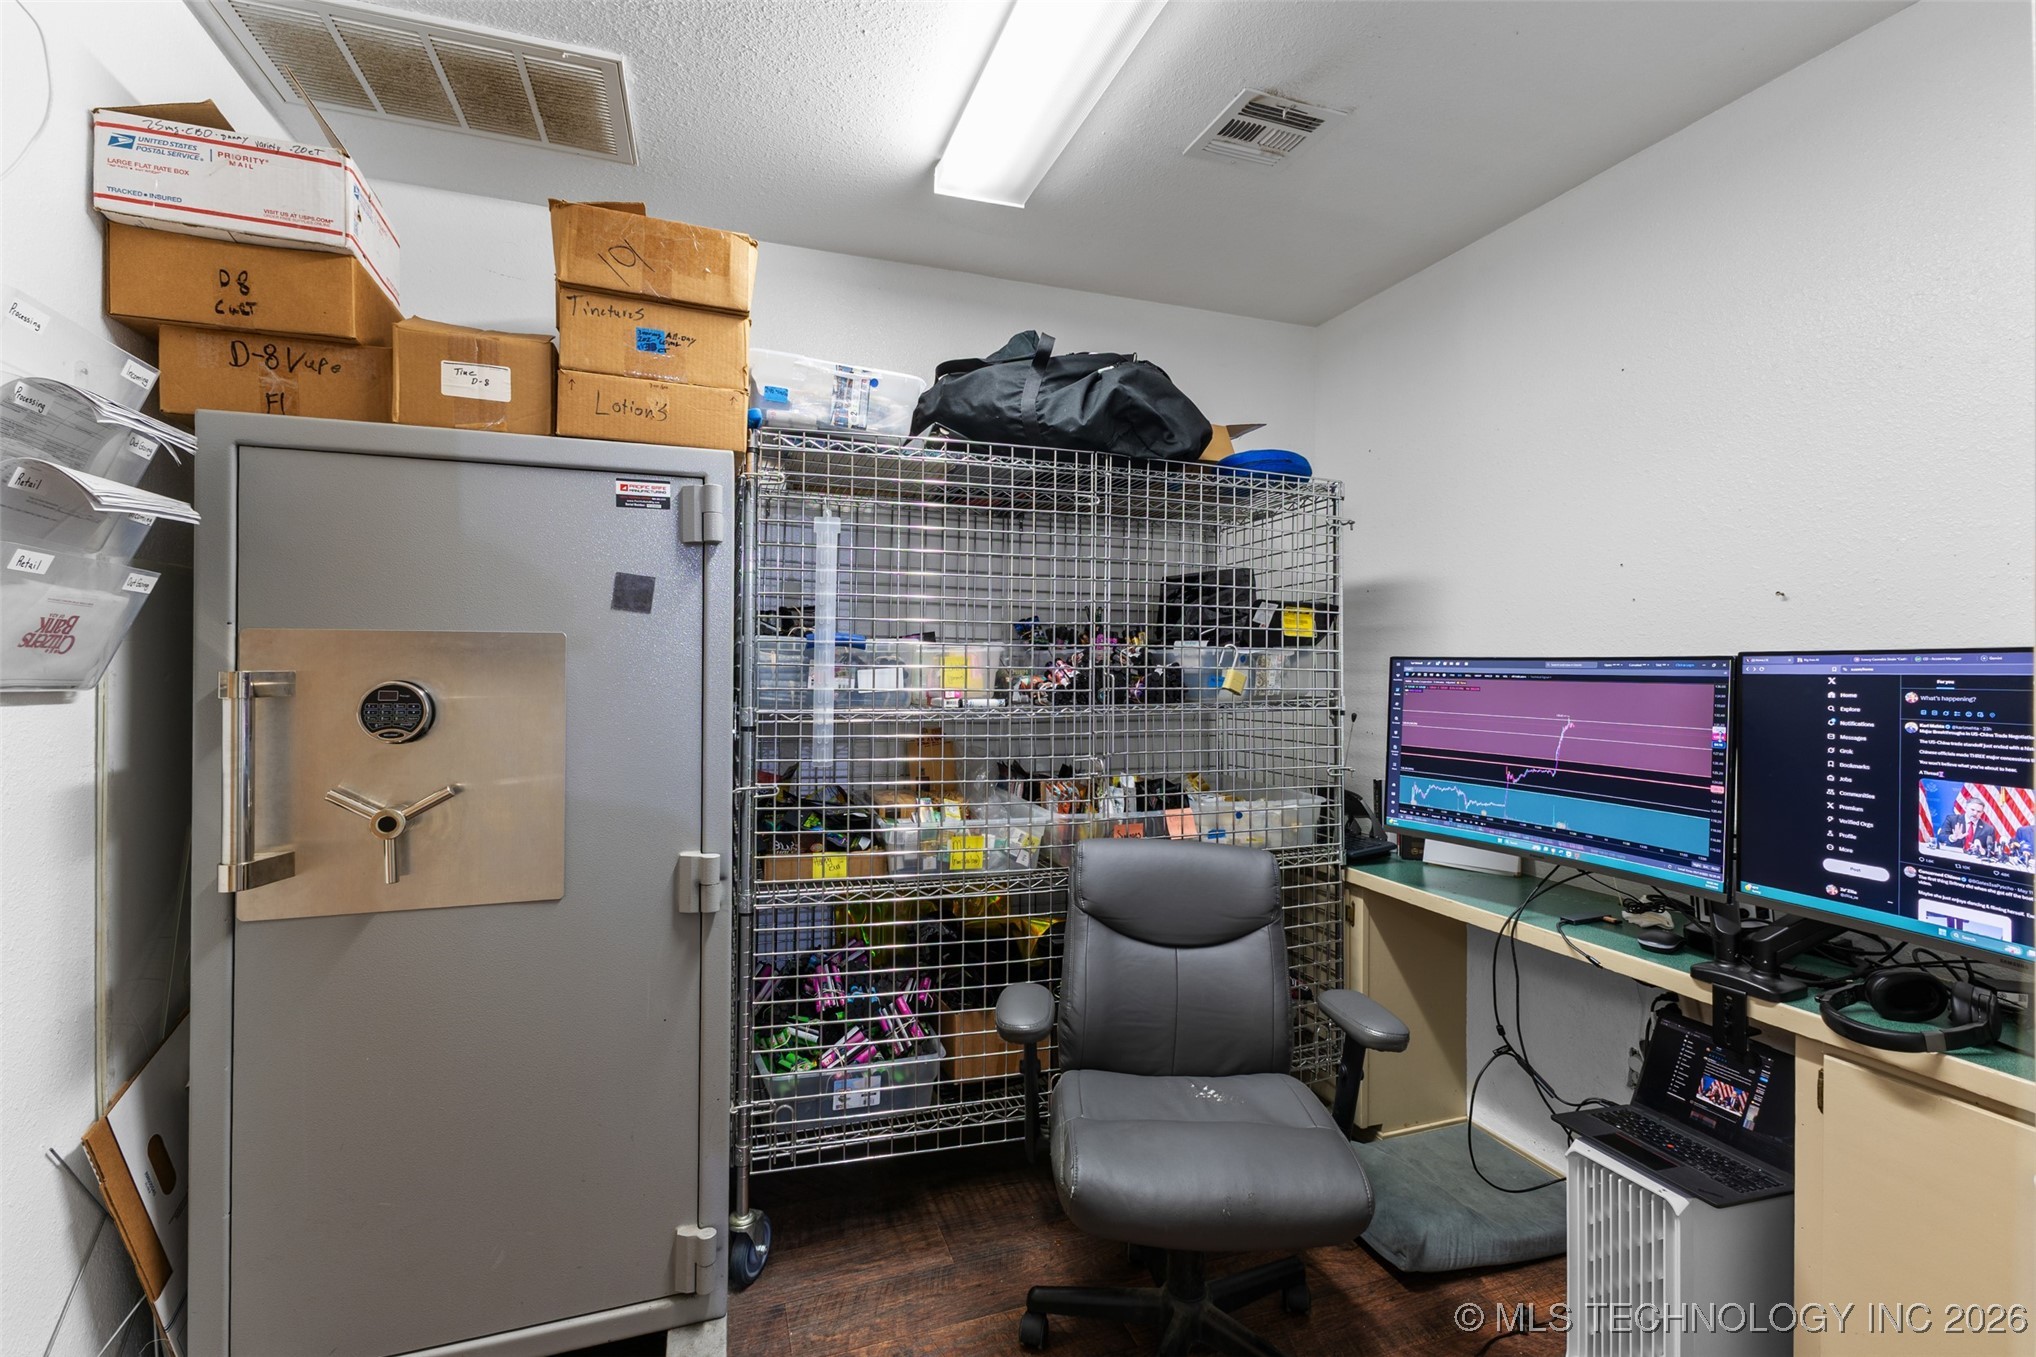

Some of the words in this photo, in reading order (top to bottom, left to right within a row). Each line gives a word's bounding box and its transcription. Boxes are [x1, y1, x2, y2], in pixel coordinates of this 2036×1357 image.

[136, 146, 166, 156] POSTAL
[138, 136, 169, 147] UNITED
[169, 140, 198, 151] STATES
[107, 158, 133, 167] LARGE
[134, 162, 151, 170] FLAT
[153, 164, 172, 173] RATE
[174, 168, 190, 176] BOX
[229, 160, 254, 169] MAIL
[106, 186, 143, 197] TRACKED
[149, 193, 182, 203] INSURED
[9, 302, 41, 331] Processing
[229, 340, 279, 370] D-8
[14, 386, 45, 413] Processing
[595, 390, 668, 421] Lotion's
[15, 473, 42, 490] Retail
[16, 555, 42, 571] Retail
[35, 615, 80, 634] Bank
[17, 632, 75, 655] Citizens
[1840, 720, 1875, 728] Notifications
[1840, 734, 1867, 742] Messages
[1839, 762, 1870, 770] Bookmarks
[1839, 790, 1875, 799] Communities
[1839, 804, 1863, 812] Premium
[1839, 818, 1859, 826] Verified
[1839, 832, 1857, 840] Profile
[1967, 900, 1985, 909] dancing
